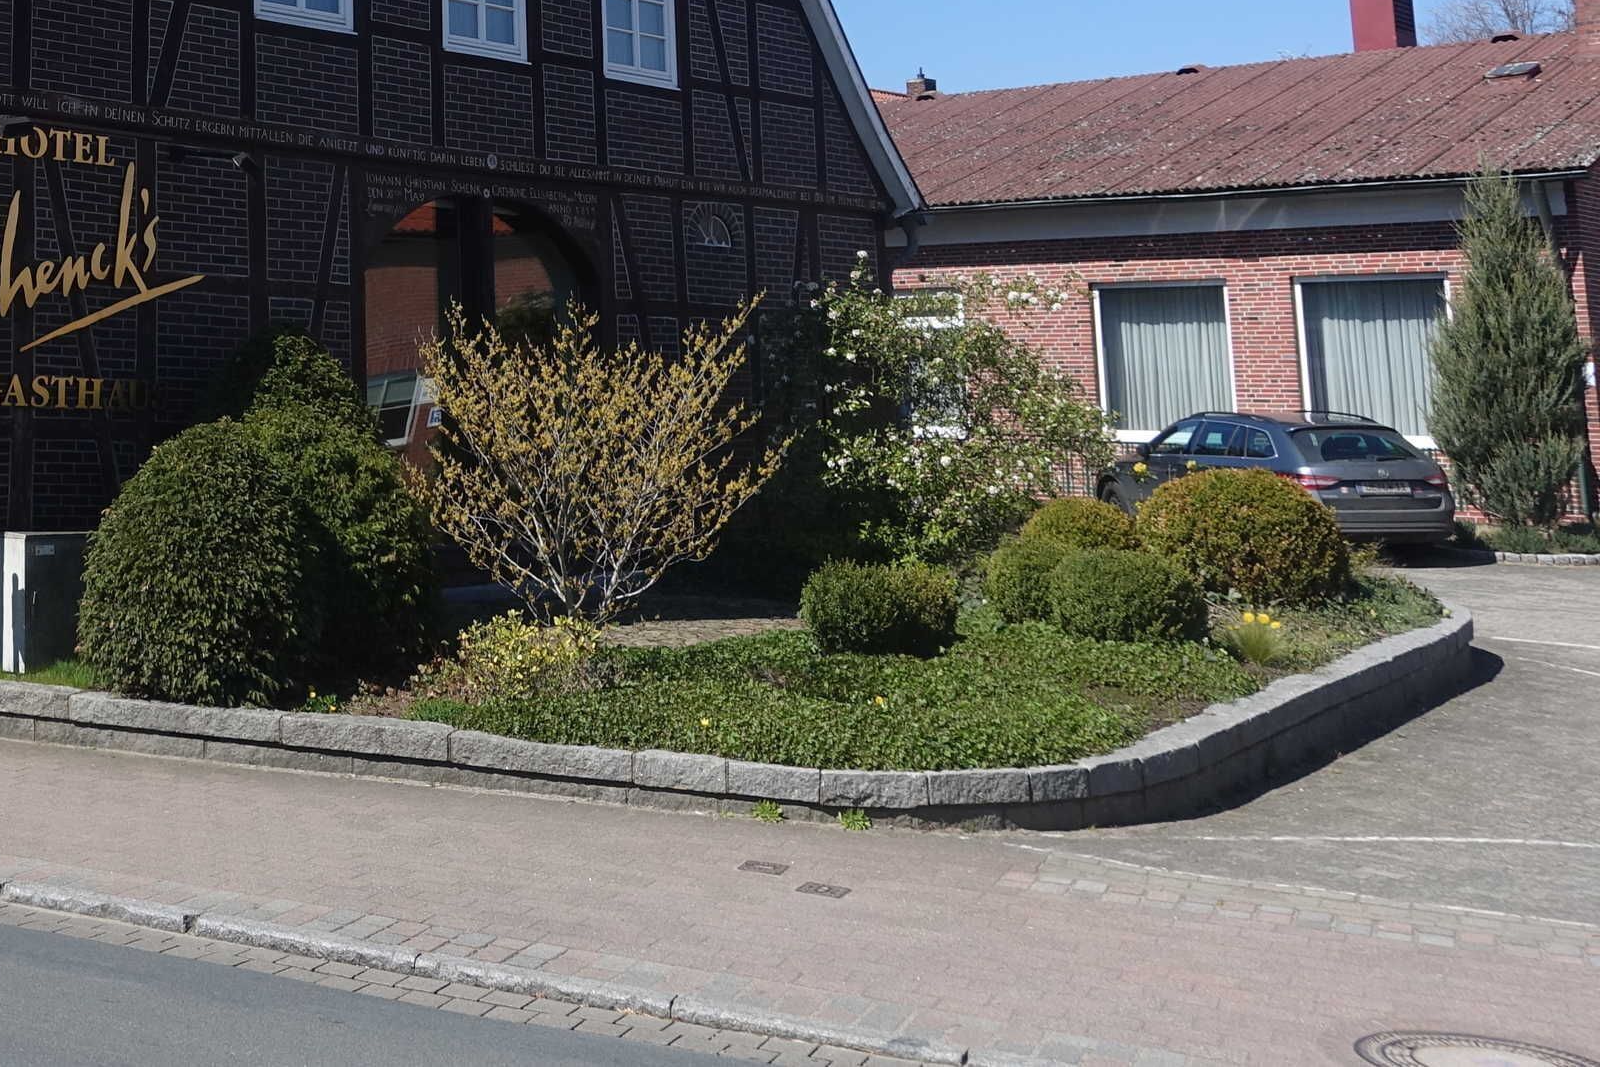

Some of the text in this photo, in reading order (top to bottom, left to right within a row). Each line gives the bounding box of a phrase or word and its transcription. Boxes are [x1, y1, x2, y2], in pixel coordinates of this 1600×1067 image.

[21, 95, 48, 111] WILL
[56, 100, 76, 115] ICH
[104, 105, 145, 124] DEINEN
[152, 110, 191, 131] SCHUTZ
[298, 133, 314, 147] DIE
[365, 143, 385, 157] UND
[430, 151, 456, 165] DARIN
[460, 154, 486, 168] LEBEN
[539, 163, 551, 175] DU
